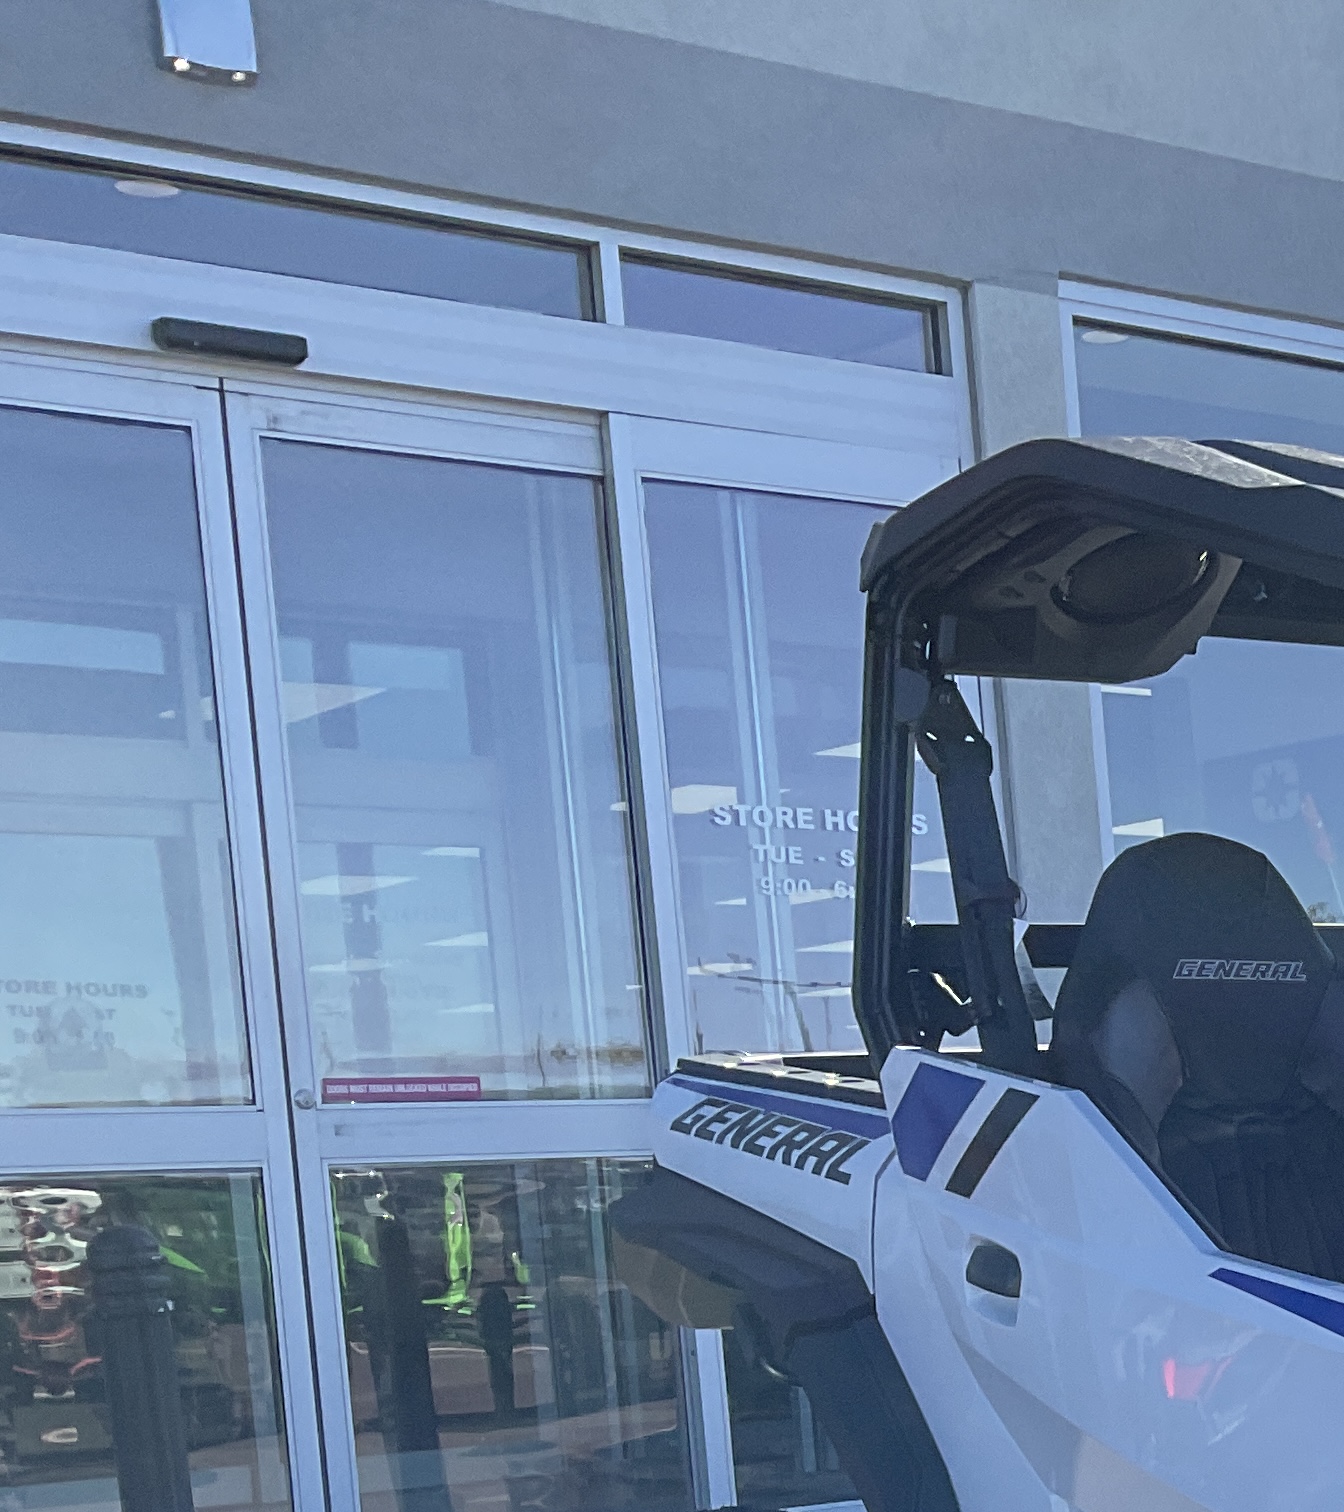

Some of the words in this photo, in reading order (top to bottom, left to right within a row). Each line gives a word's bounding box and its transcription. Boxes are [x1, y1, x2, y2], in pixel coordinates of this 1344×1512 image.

[712, 804, 815, 829] STORE
[824, 808, 928, 835] HOS
[753, 843, 804, 864] TUE
[760, 878, 811, 896] 9:00
[1173, 958, 1306, 982] GENERAL
[65, 981, 148, 999] HOURS
[669, 1096, 873, 1186] GENERAL
